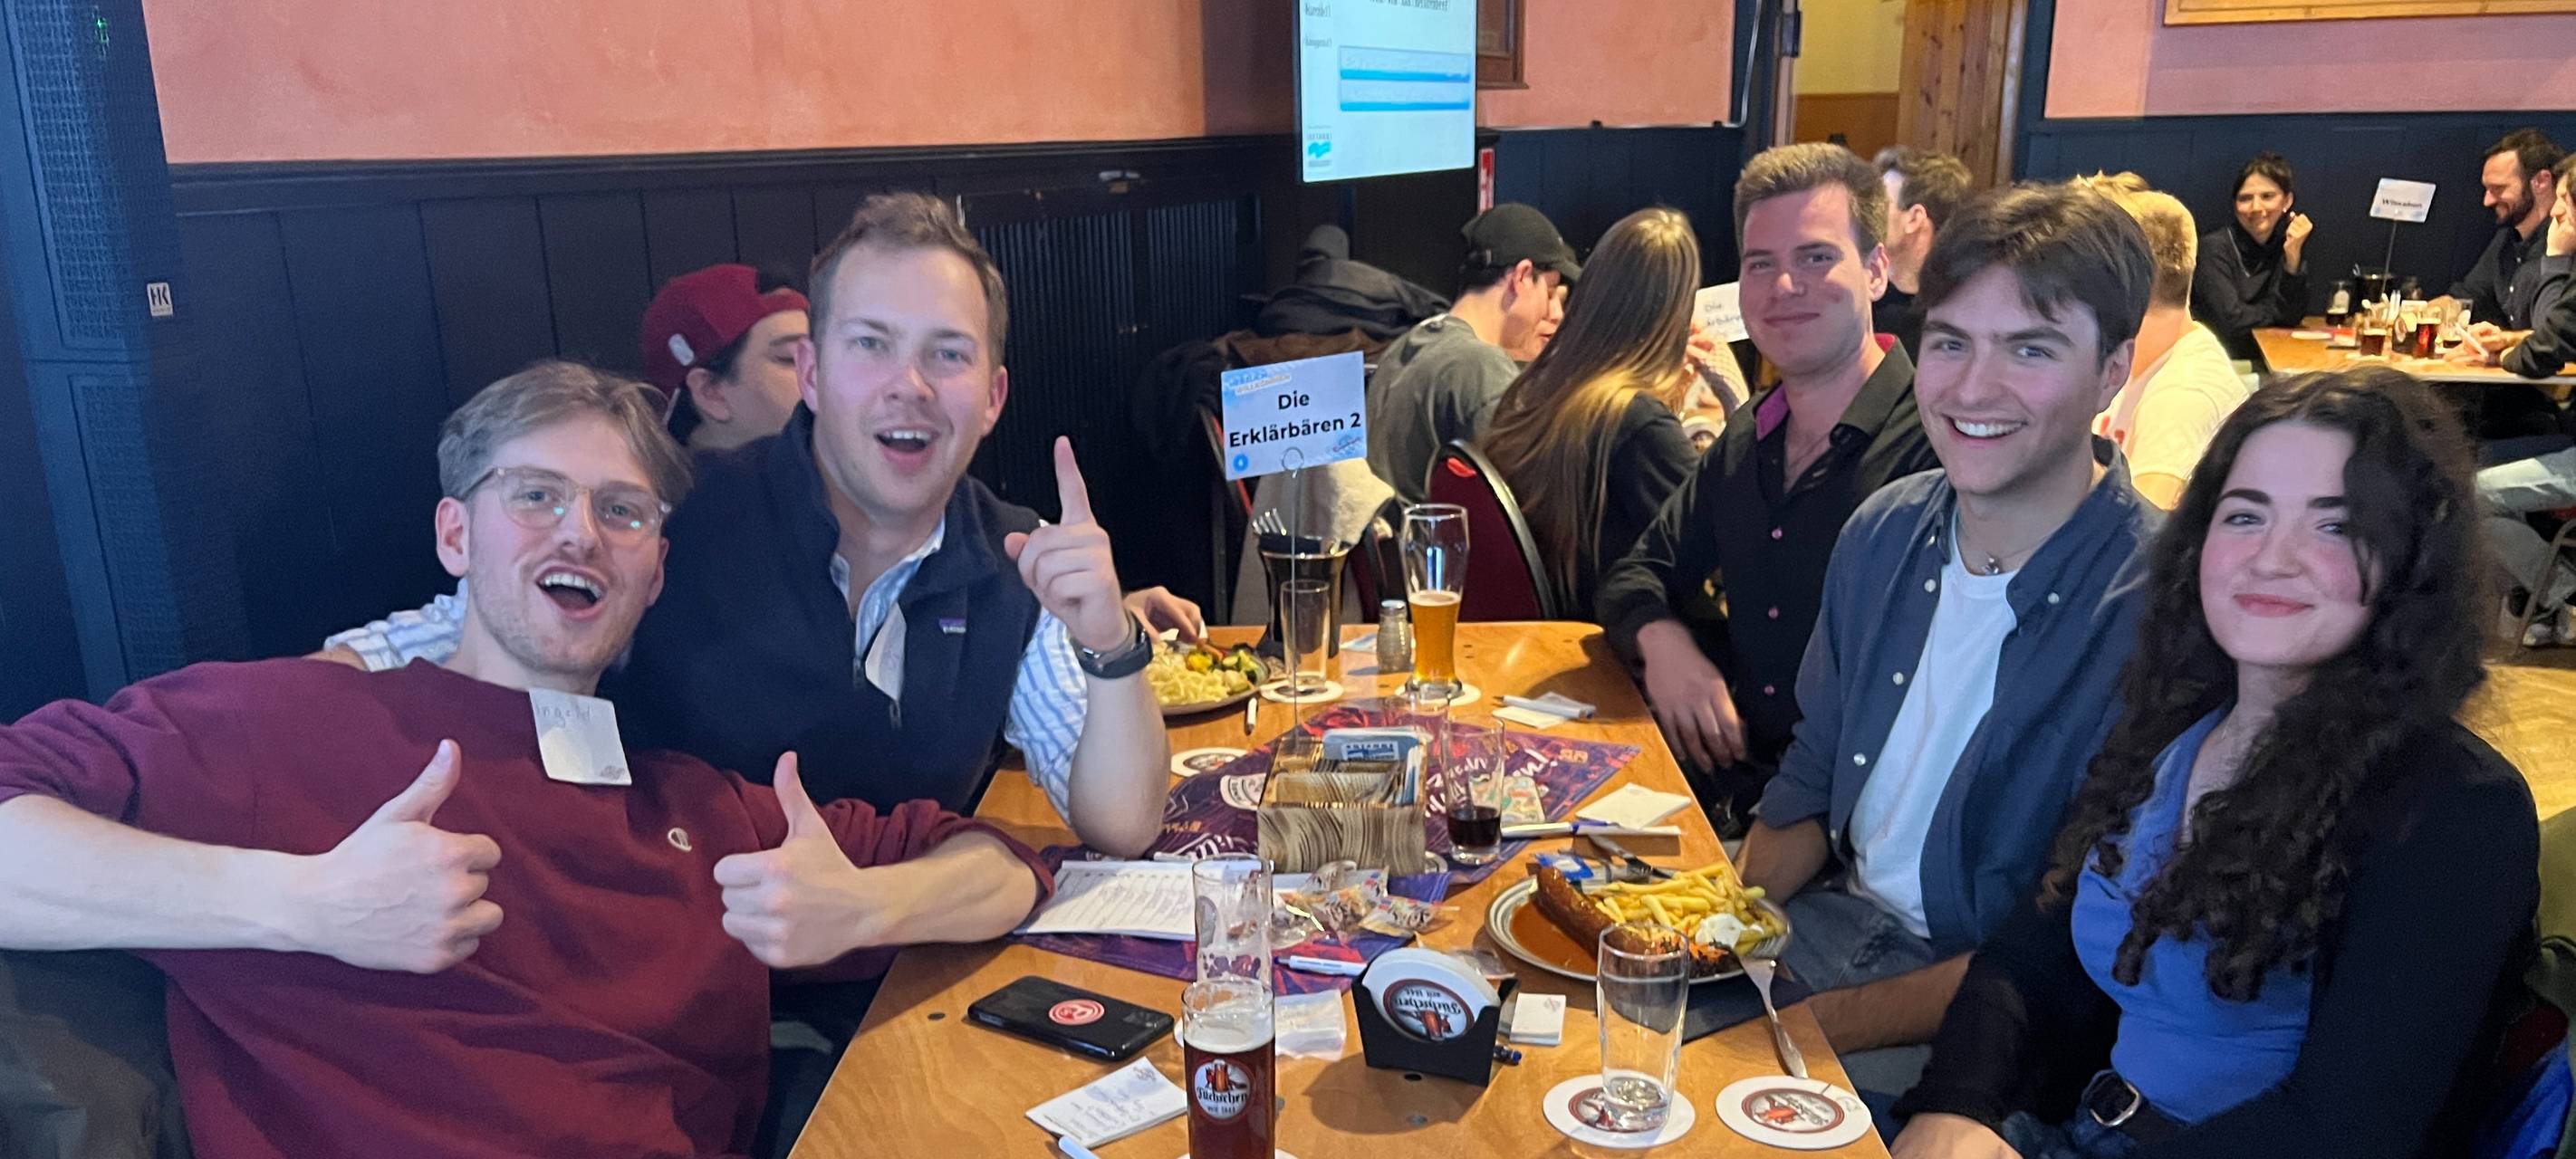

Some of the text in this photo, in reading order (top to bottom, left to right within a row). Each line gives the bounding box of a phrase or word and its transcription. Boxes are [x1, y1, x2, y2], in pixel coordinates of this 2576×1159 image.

[1278, 390, 1310, 409] Die
[1229, 417, 1344, 447] Erklärbären
[1350, 412, 1361, 428] 2
